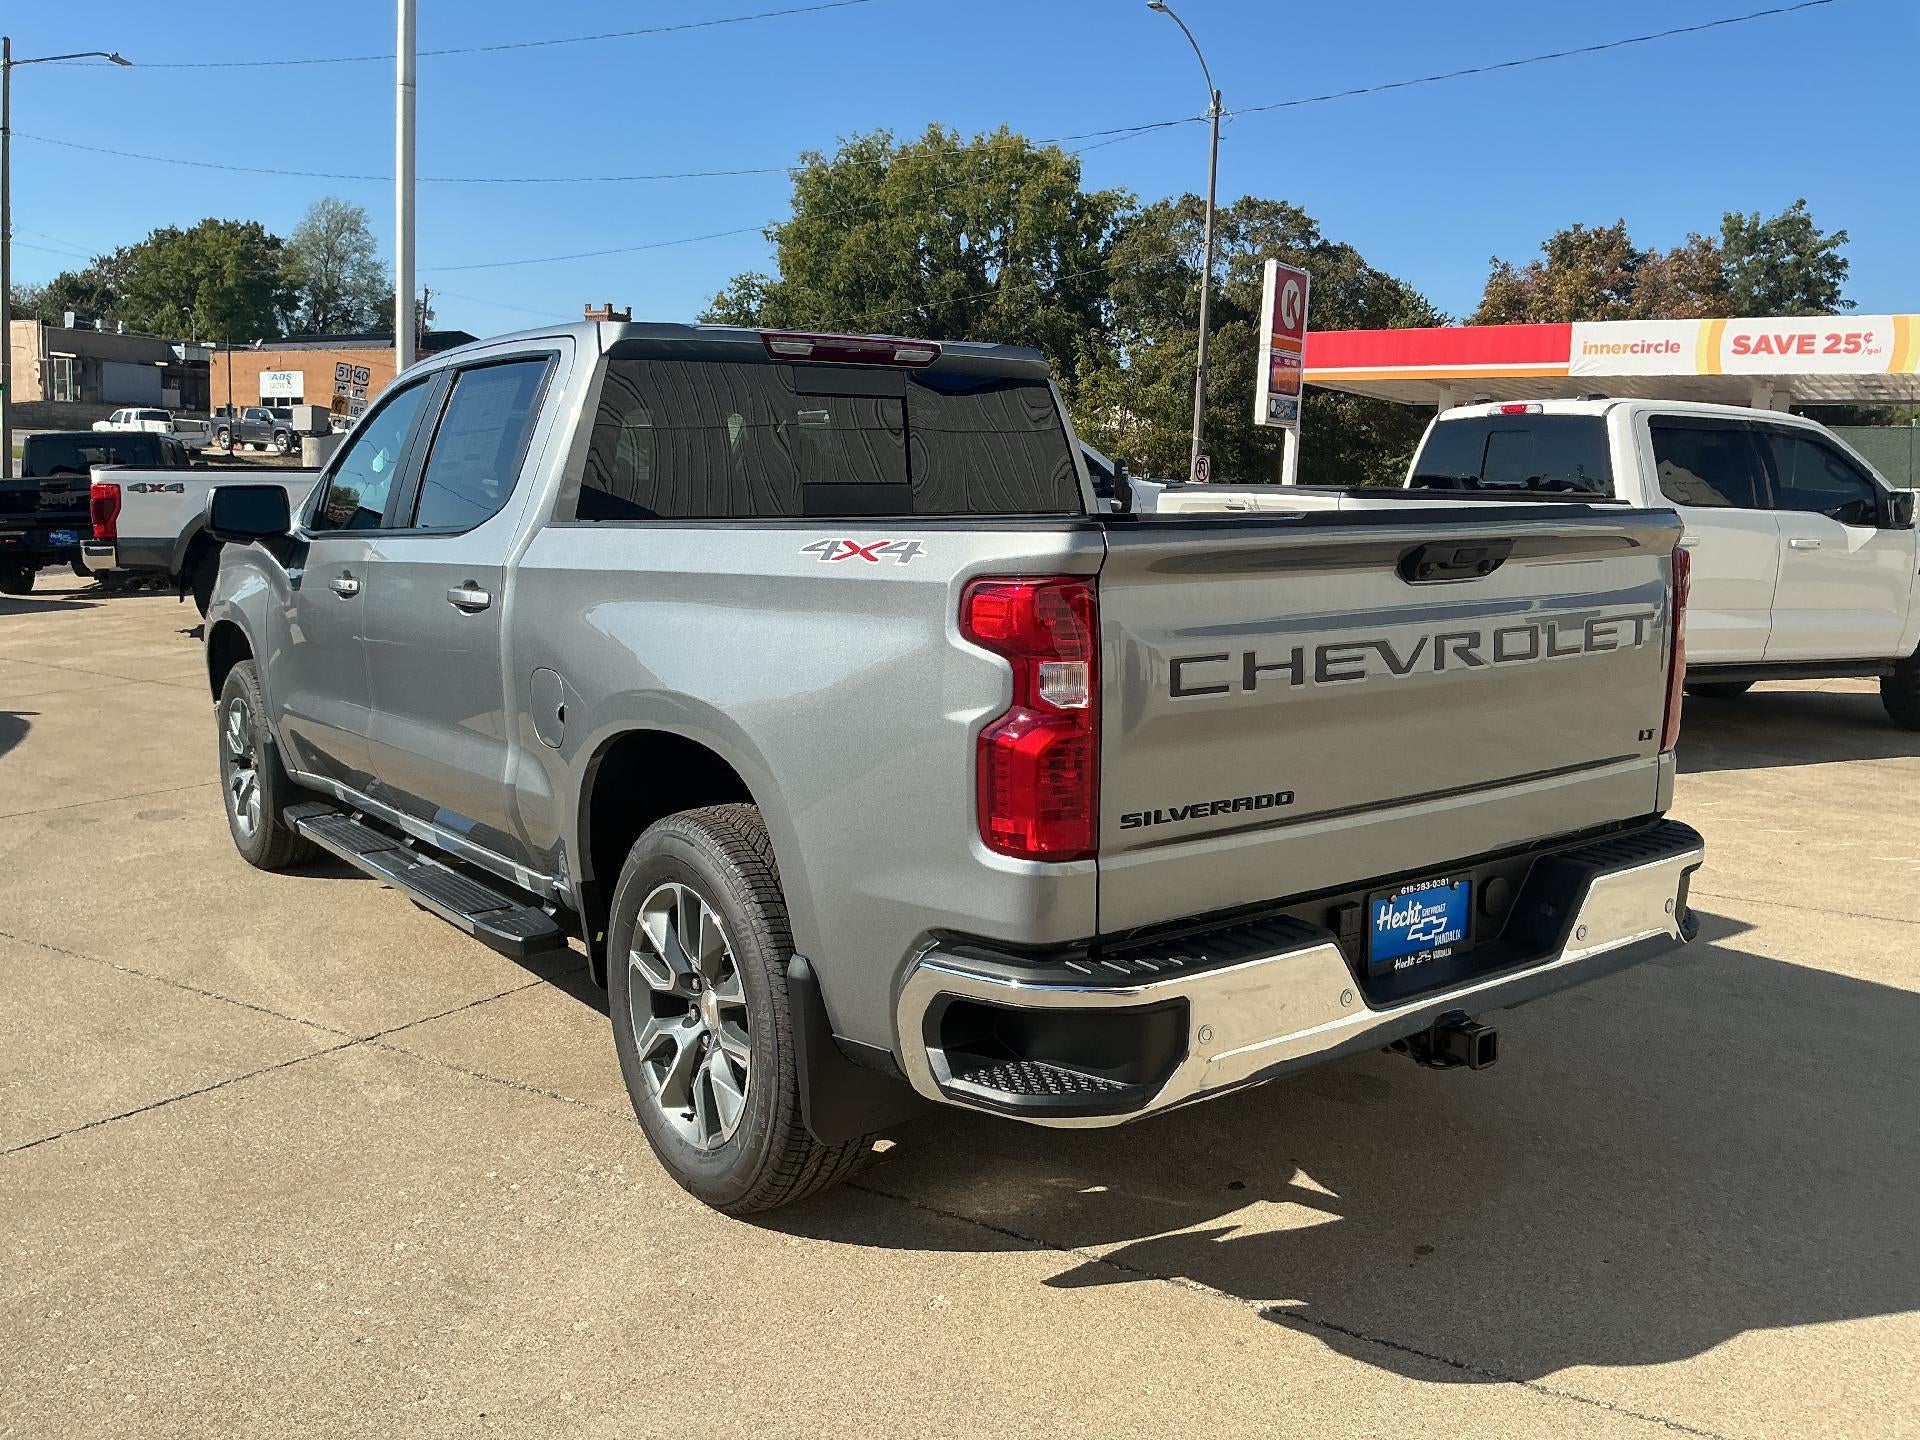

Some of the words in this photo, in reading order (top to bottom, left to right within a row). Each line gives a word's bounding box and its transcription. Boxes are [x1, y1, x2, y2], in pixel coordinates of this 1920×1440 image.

[1286, 289, 1300, 324] K
[1582, 340, 1681, 355] innercircle
[1731, 332, 1816, 355] SAVE
[338, 366, 349, 378] 51
[355, 371, 368, 381] 40
[1168, 611, 1656, 698] CHEVROLET
[1638, 728, 1657, 741] LT
[1119, 790, 1295, 829] SILVERADO
[1376, 900, 1422, 931] Hecht
[1393, 955, 1415, 970] Hecht
